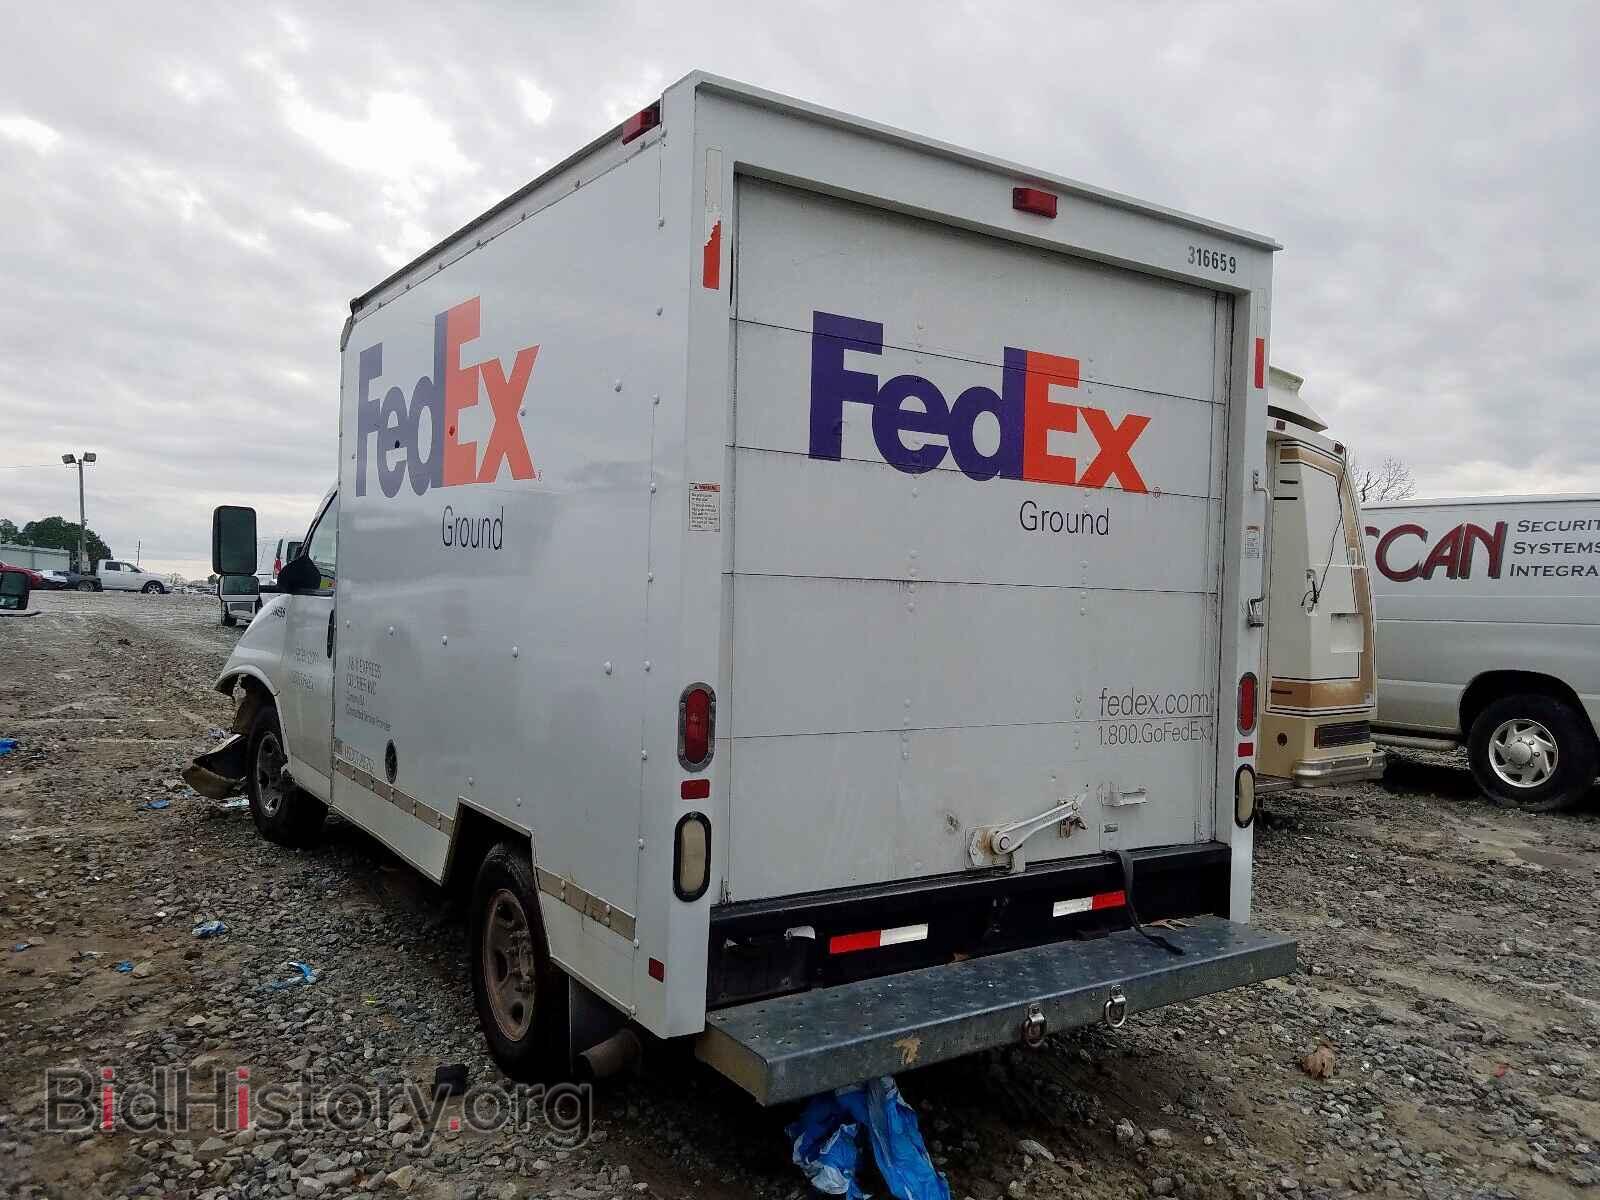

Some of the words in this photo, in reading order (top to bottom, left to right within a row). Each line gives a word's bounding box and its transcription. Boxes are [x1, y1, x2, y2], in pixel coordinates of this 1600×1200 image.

[1188, 245, 1237, 274] 316659
[356, 296, 541, 498] FedEx
[808, 310, 1152, 494] FedEx
[442, 505, 504, 550] Ground
[1019, 500, 1111, 536] Ground
[1098, 688, 1209, 717] fedex.com
